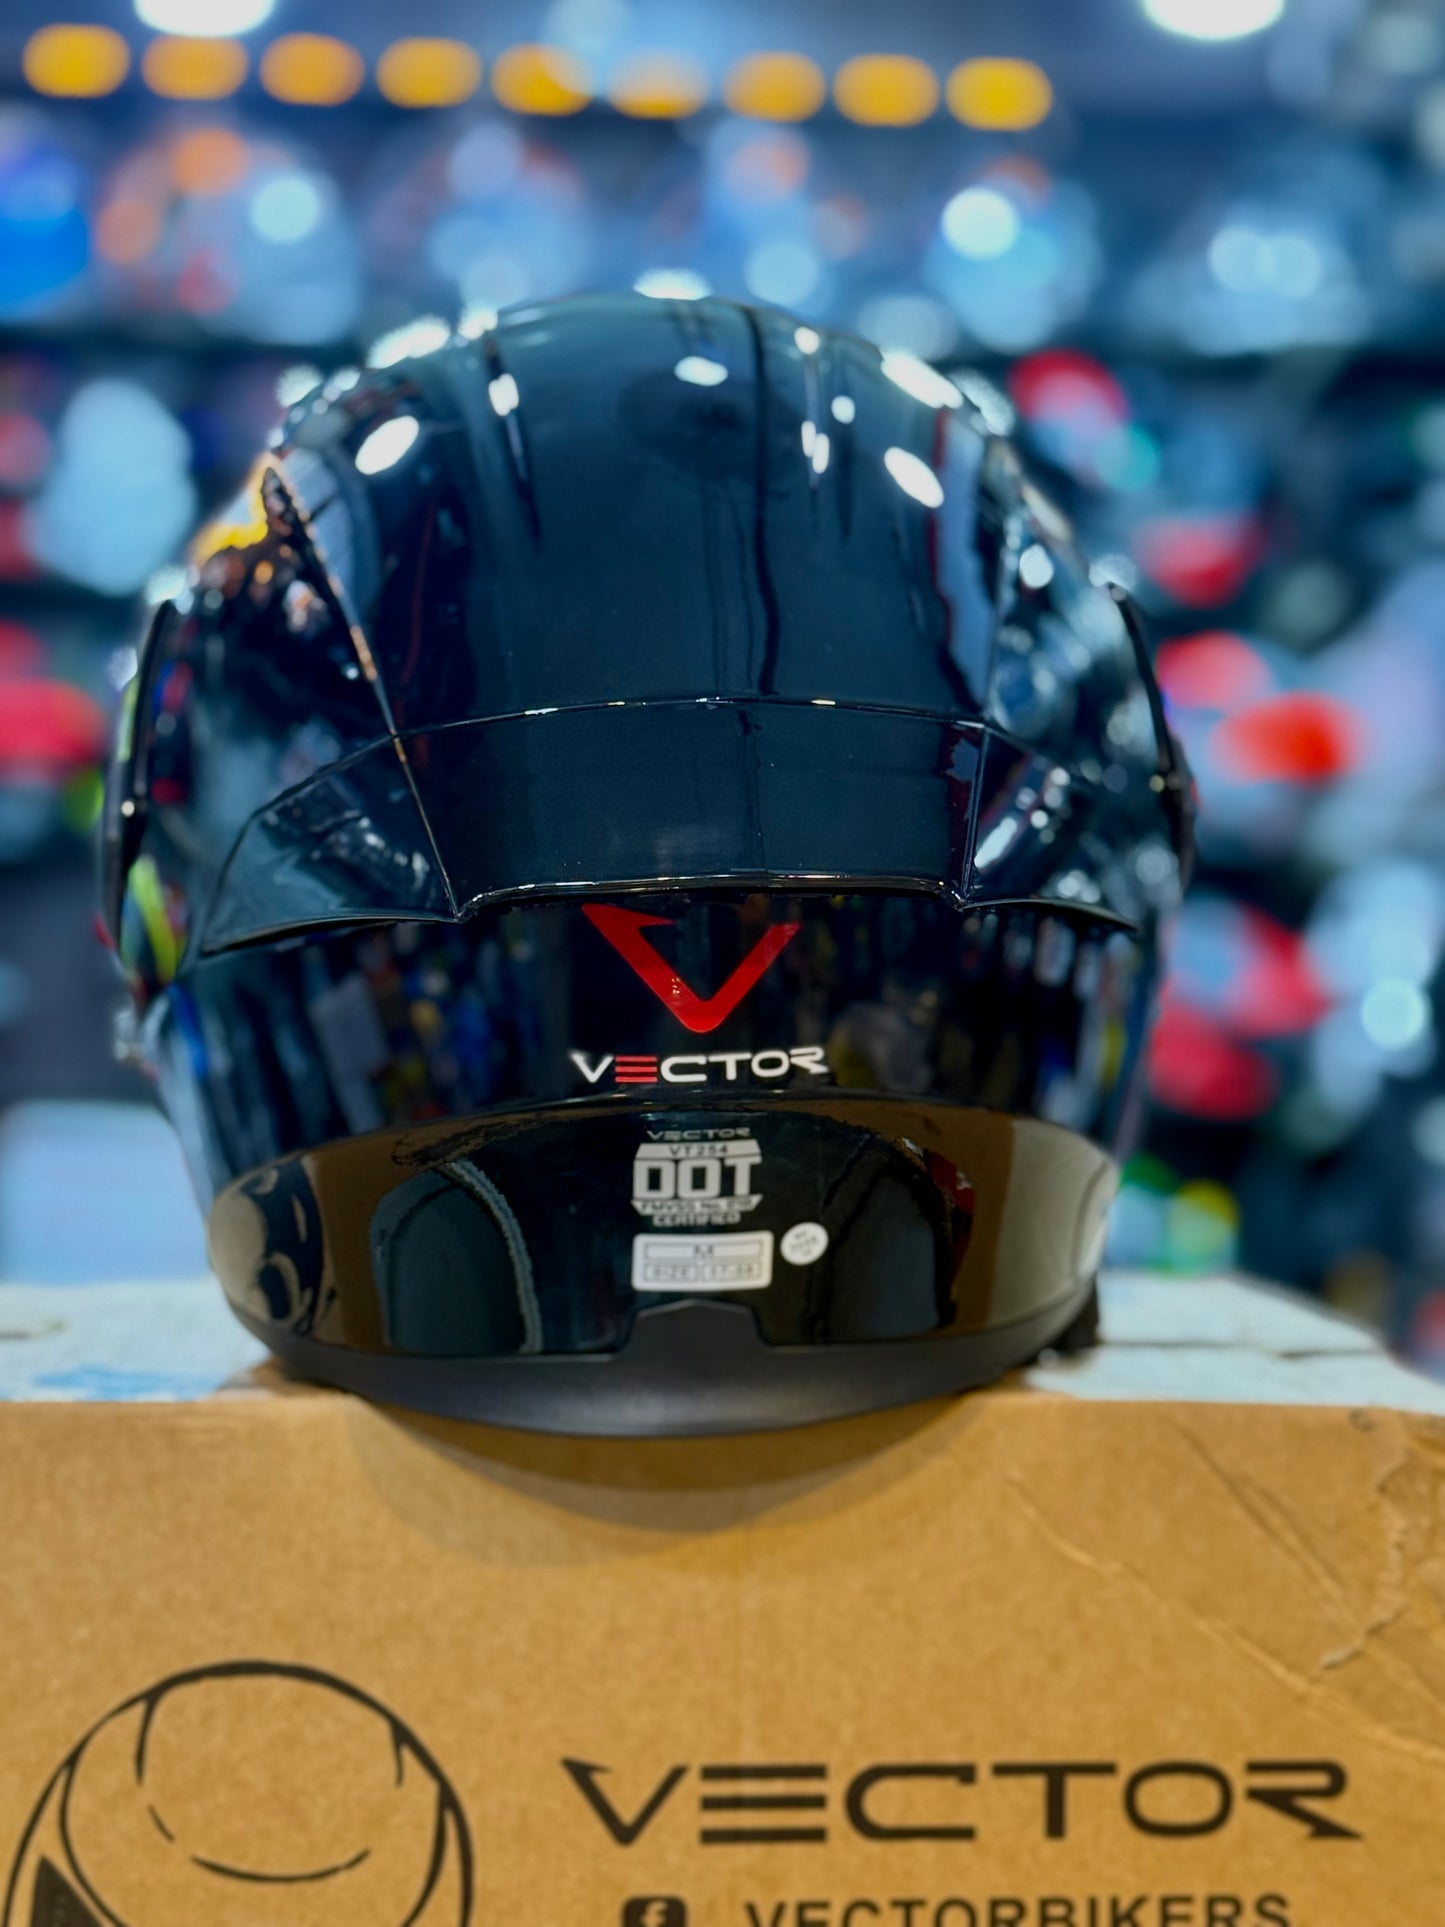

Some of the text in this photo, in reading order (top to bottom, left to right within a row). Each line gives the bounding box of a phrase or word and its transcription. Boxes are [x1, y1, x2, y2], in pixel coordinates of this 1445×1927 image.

[570, 1047, 829, 1083] VECTOR
[647, 1127, 750, 1141] VECTOR
[669, 1144, 729, 1157] VT254
[633, 1155, 762, 1200] DOT
[560, 1757, 1363, 1846] VECTOR
